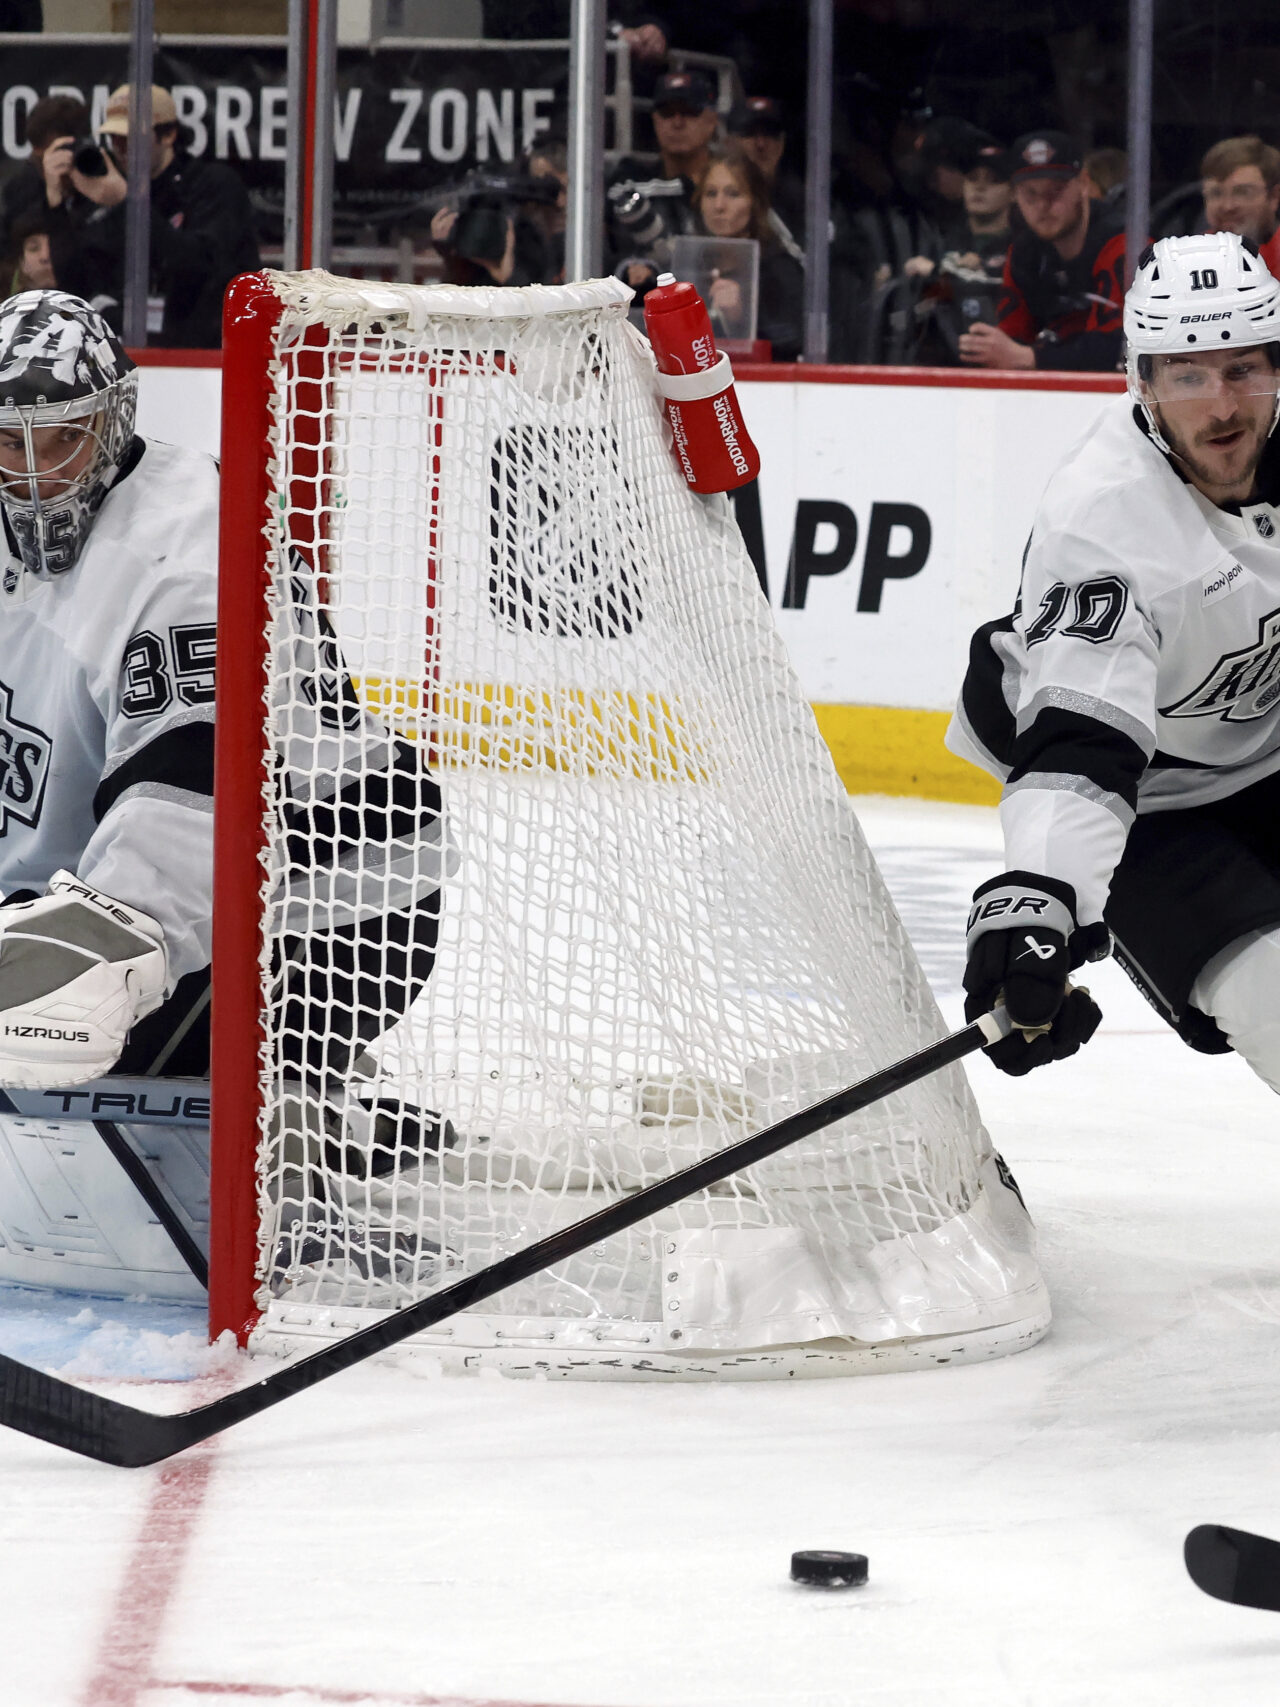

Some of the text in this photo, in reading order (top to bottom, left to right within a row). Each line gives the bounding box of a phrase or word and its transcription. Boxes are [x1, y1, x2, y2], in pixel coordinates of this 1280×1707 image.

[1188, 268, 1219, 291] 10
[1179, 311, 1233, 324] BAUER
[668, 404, 697, 483] BODYARMOR
[713, 396, 749, 477] BODYARMOR
[1024, 576, 1129, 653] 10
[121, 622, 218, 720] 35
[53, 881, 135, 926] TRUE
[4, 1025, 91, 1043] HZRDUS
[42, 1090, 212, 1120] TRUE
